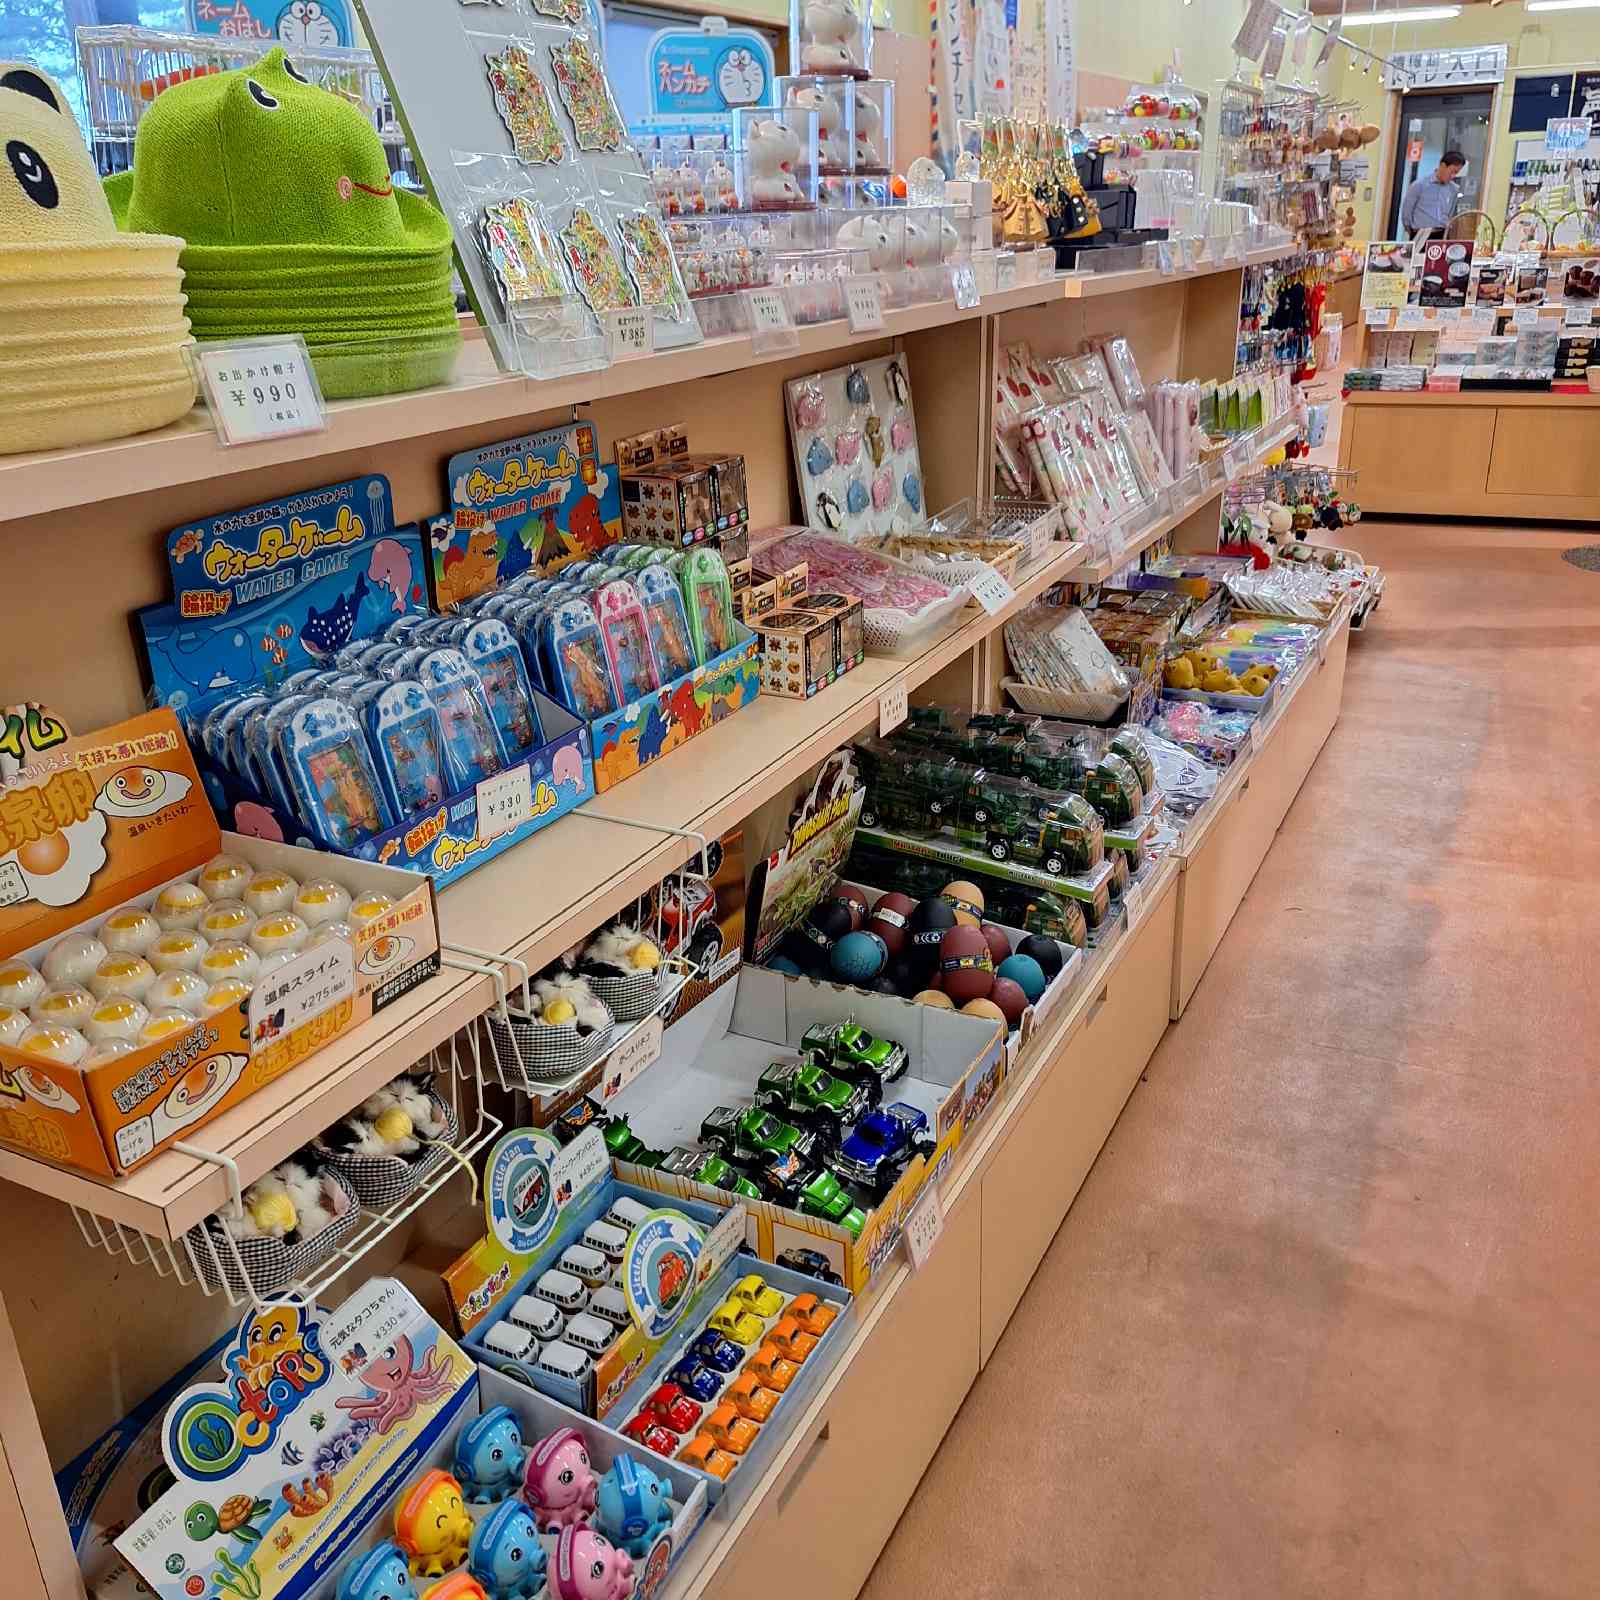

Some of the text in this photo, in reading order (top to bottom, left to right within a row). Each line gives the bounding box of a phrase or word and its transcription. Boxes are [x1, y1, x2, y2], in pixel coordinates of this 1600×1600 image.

[218, 20, 272, 38] おはし
[218, 361, 296, 382] お出かけ帽子
[230, 382, 297, 408] ¥990
[467, 446, 577, 504] ウォーターゲーム
[490, 500, 527, 521] WATER
[531, 487, 562, 510] GAME
[203, 505, 365, 584] ウォーターゲーム
[181, 551, 352, 618] 輪投げ WATER GAME
[405, 807, 448, 857] 輪投げ
[263, 954, 341, 1008] 温泉スライム
[301, 986, 330, 1011] ¥275
[494, 1145, 521, 1200] Little Van
[631, 1259, 643, 1298] Little
[328, 1286, 396, 1349] 元気なタコちゃん
[373, 1315, 399, 1340] ¥330
